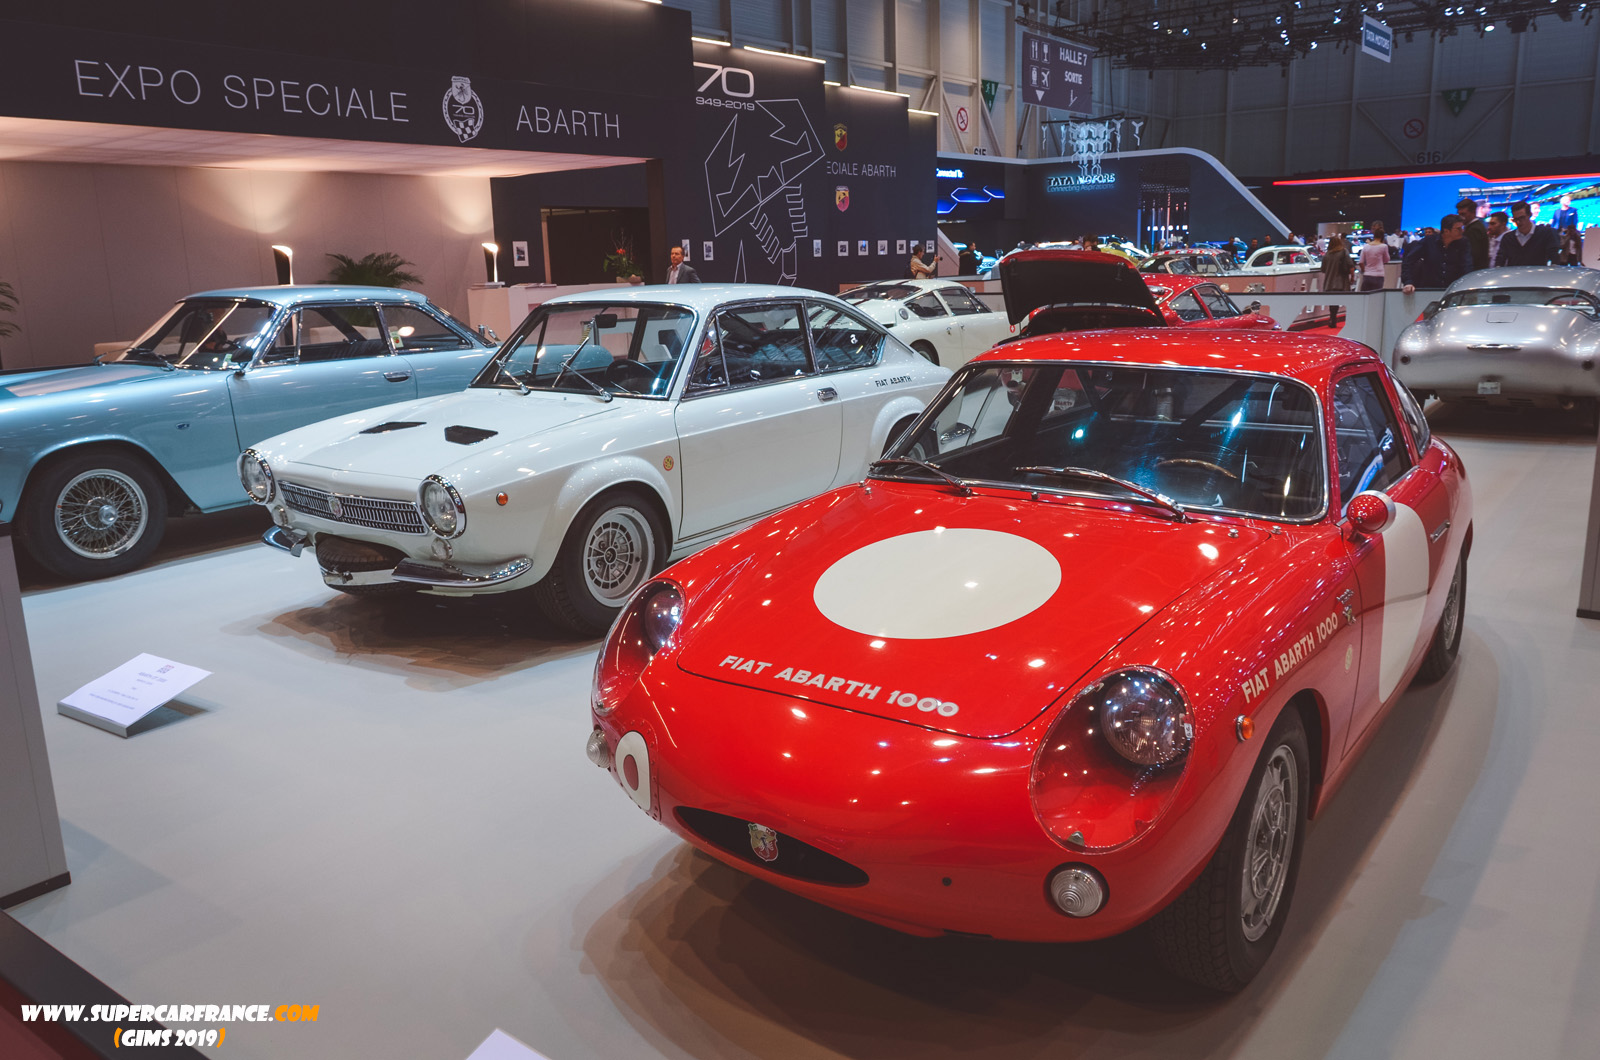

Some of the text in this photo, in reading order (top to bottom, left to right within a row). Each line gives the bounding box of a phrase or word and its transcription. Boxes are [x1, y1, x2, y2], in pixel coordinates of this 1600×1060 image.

[1060, 47, 1088, 66] HALLE 7
[693, 61, 754, 98] 70
[1064, 71, 1083, 85] SORTIE
[74, 59, 410, 123] EXPO SPECIALE
[452, 104, 475, 115] 70
[516, 105, 620, 139] ABARTH
[1416, 151, 1441, 165] 616
[861, 163, 897, 178] ABARTH
[1047, 176, 1075, 187] TATA
[1047, 183, 1080, 193] Connecting
[875, 375, 912, 388] FIAT ABARTH
[1241, 612, 1338, 704] FIAT ABARTH 1000
[718, 655, 959, 717] FIAT ABARTH 1000
